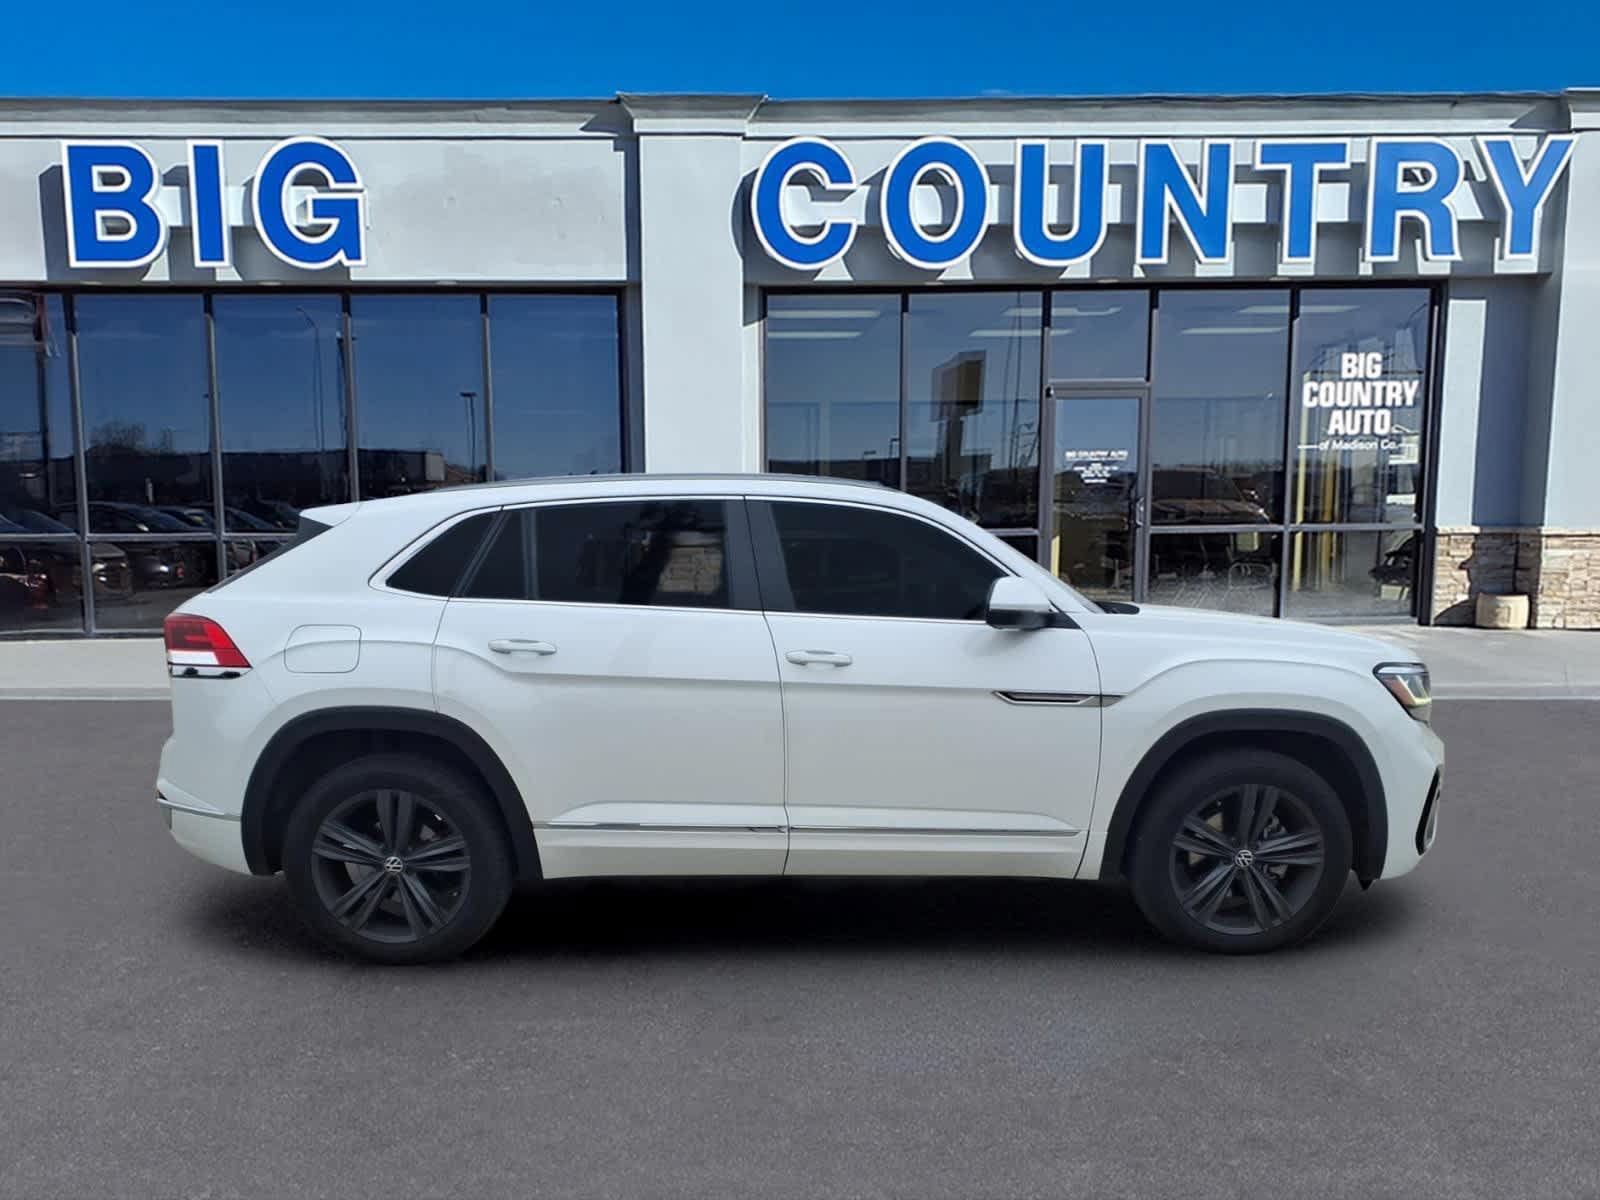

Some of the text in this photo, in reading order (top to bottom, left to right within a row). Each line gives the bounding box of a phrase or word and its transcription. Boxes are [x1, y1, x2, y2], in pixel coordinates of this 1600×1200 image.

[61, 136, 1575, 271] BIG COUNTRY
[1342, 352, 1382, 379] BIG
[1303, 380, 1419, 408] COUNTRY
[1328, 409, 1391, 435] AUTO
[1319, 440, 1329, 451] of
[1331, 440, 1378, 450] Madison
